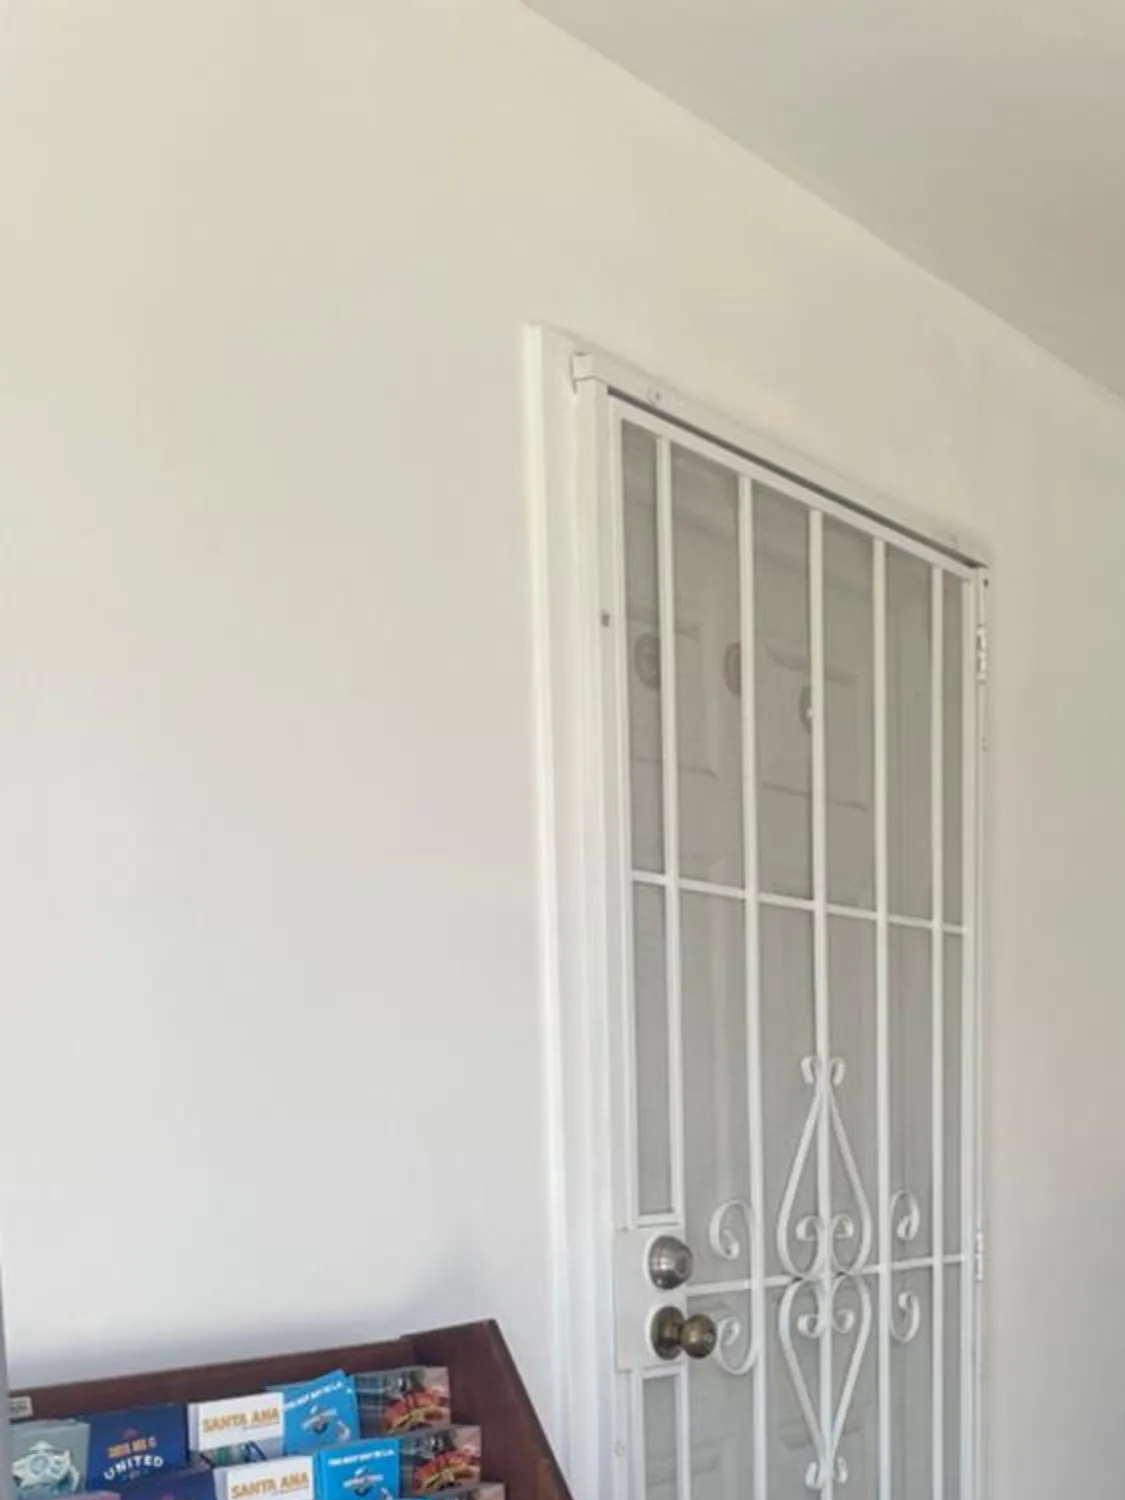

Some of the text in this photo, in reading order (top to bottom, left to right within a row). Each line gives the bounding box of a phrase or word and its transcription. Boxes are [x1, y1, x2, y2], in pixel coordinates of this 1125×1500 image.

[202, 1406, 280, 1430] SANTA ANA
[104, 1455, 164, 1481] UNITED
[231, 1471, 309, 1500] SANTA ANA
